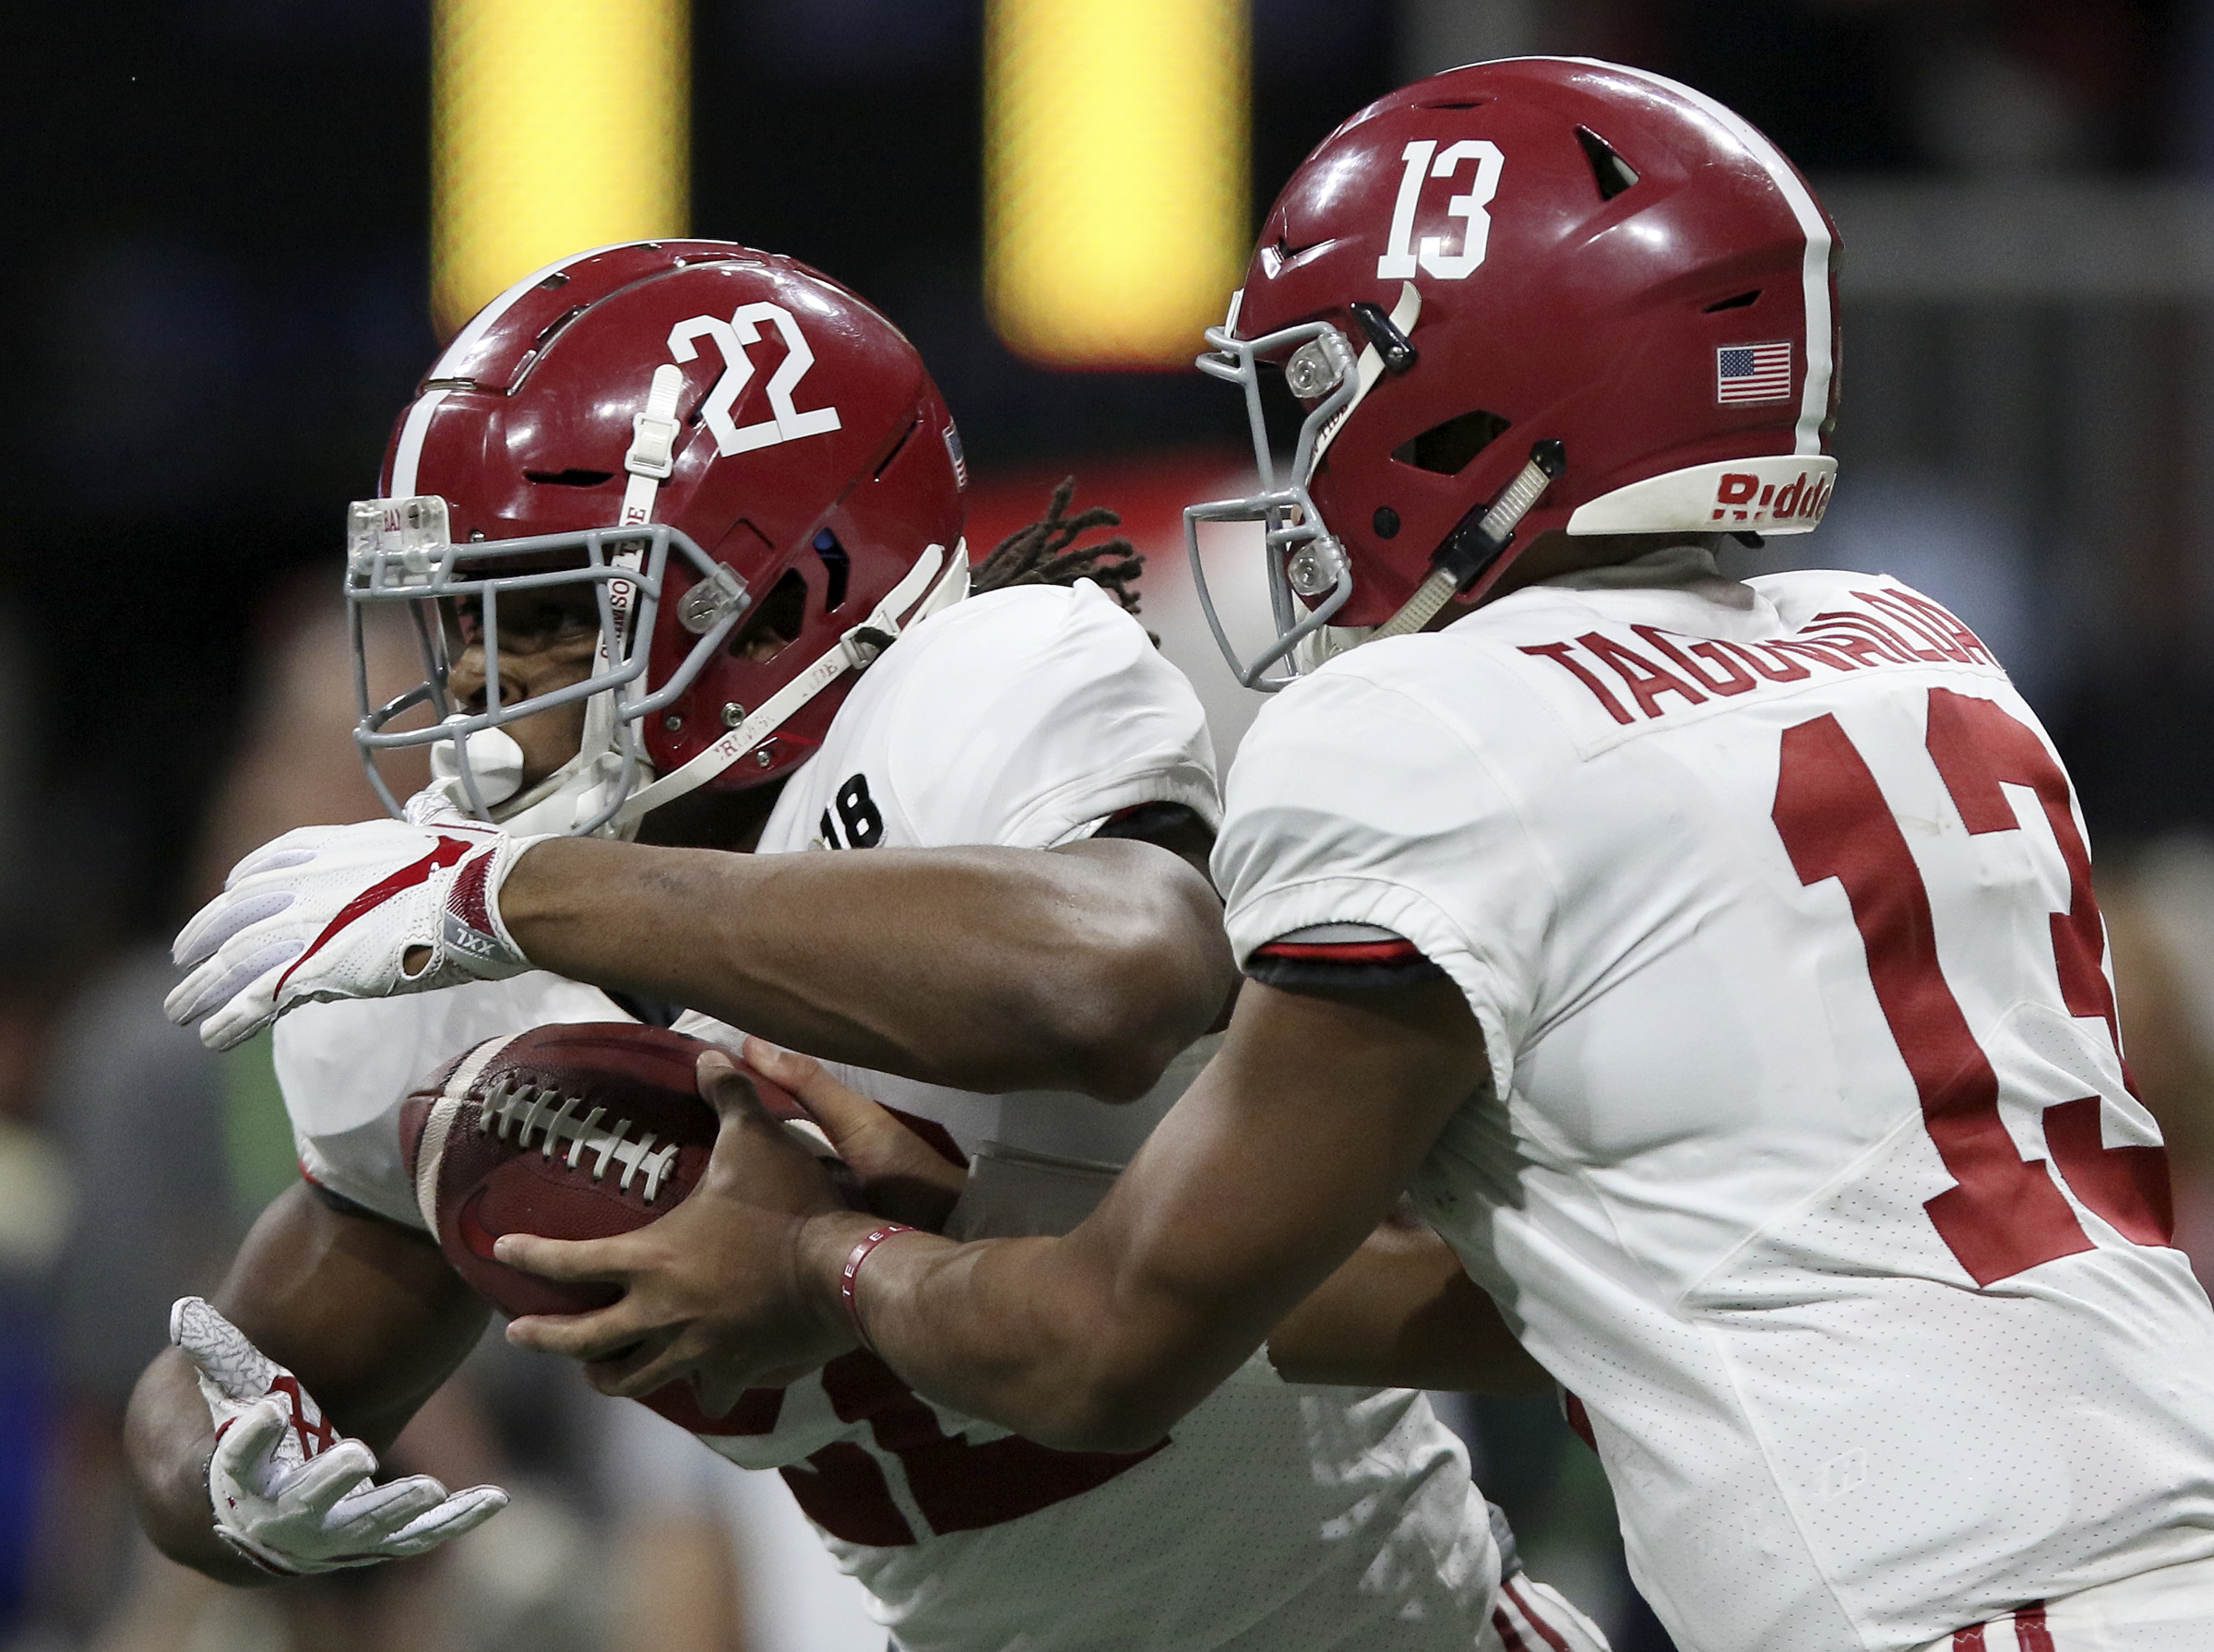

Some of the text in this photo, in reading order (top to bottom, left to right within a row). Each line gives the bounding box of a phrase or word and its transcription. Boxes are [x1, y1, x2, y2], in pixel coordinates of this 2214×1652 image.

[1377, 140, 1505, 279] 13
[666, 301, 842, 457] 22
[457, 926, 496, 956] XXL
[1772, 686, 2175, 1289] 13
